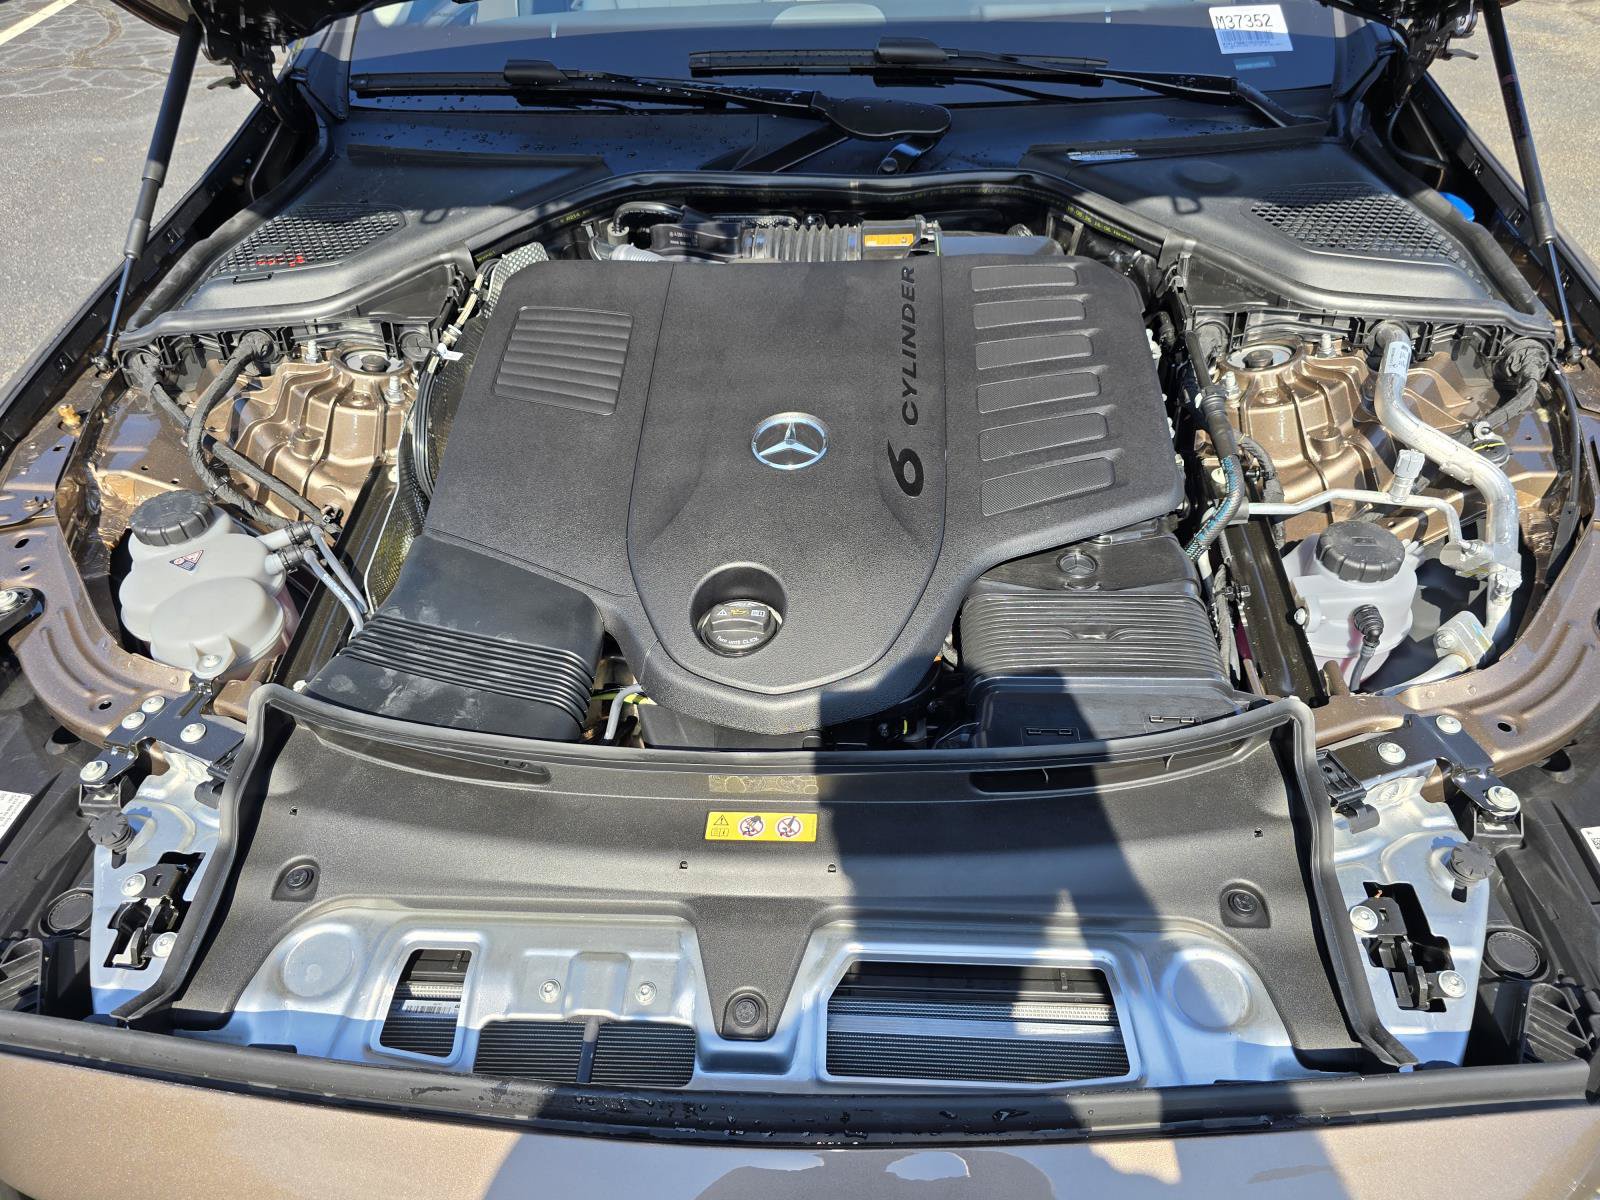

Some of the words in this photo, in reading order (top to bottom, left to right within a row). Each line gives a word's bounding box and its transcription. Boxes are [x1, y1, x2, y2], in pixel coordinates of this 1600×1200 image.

[1215, 13, 1273, 29] M37352
[901, 265, 919, 426] CYLINDER
[887, 439, 925, 498] 6
